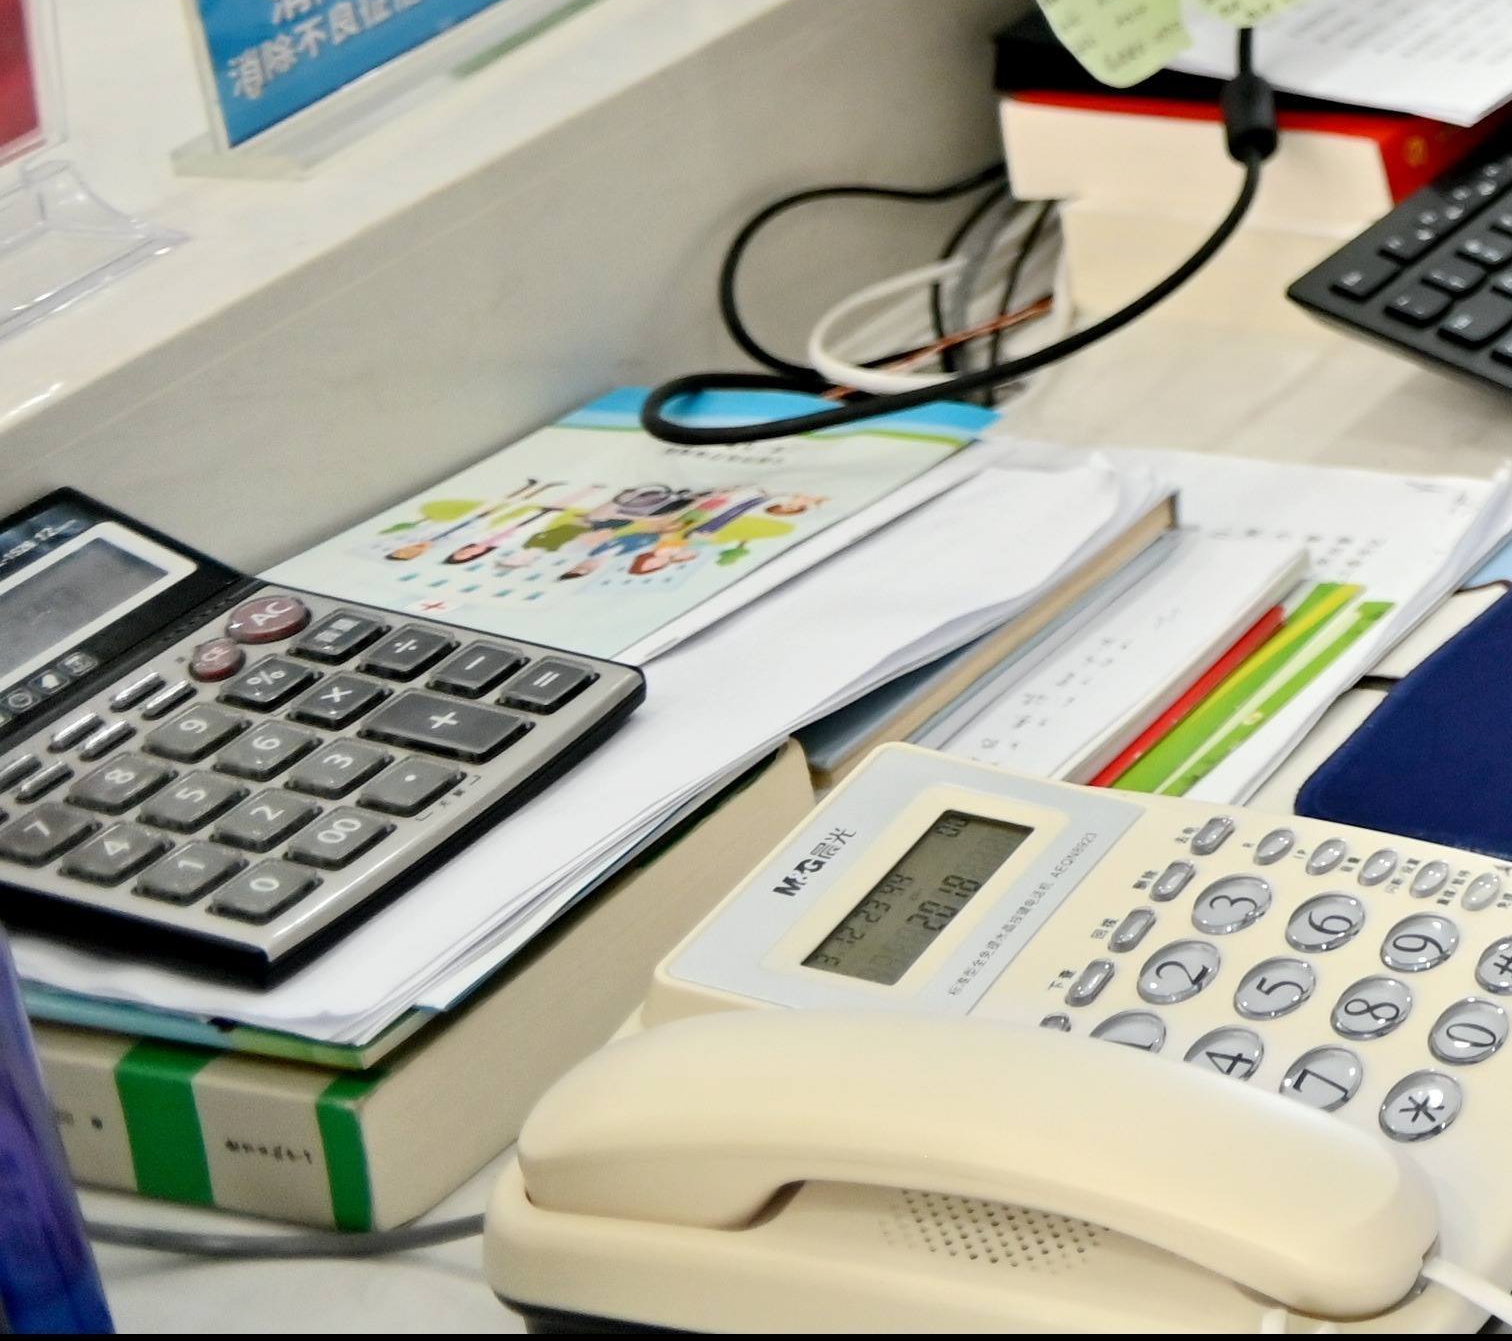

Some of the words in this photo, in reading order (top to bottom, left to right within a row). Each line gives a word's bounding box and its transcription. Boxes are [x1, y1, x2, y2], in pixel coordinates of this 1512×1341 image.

[249, 601, 293, 627] AC
[179, 719, 207, 734] 9
[253, 736, 281, 751] 6
[323, 754, 353, 768] 3
[105, 769, 136, 784] 8
[176, 788, 206, 802] 5
[250, 805, 285, 822] 2
[24, 821, 50, 837] 7
[317, 818, 361, 844] 00
[104, 839, 130, 856] 4
[177, 859, 205, 870] 1
[250, 877, 279, 892] 0
[1208, 893, 1260, 912] 3
[1308, 910, 1355, 936] 6
[1392, 933, 1446, 958] 9
[1155, 960, 1210, 986] 2
[1256, 976, 1306, 997] 5
[1344, 998, 1400, 1021] 8
[1446, 1022, 1497, 1048] 0
[1206, 1050, 1254, 1077] 4
[1293, 1067, 1351, 1100] 7
